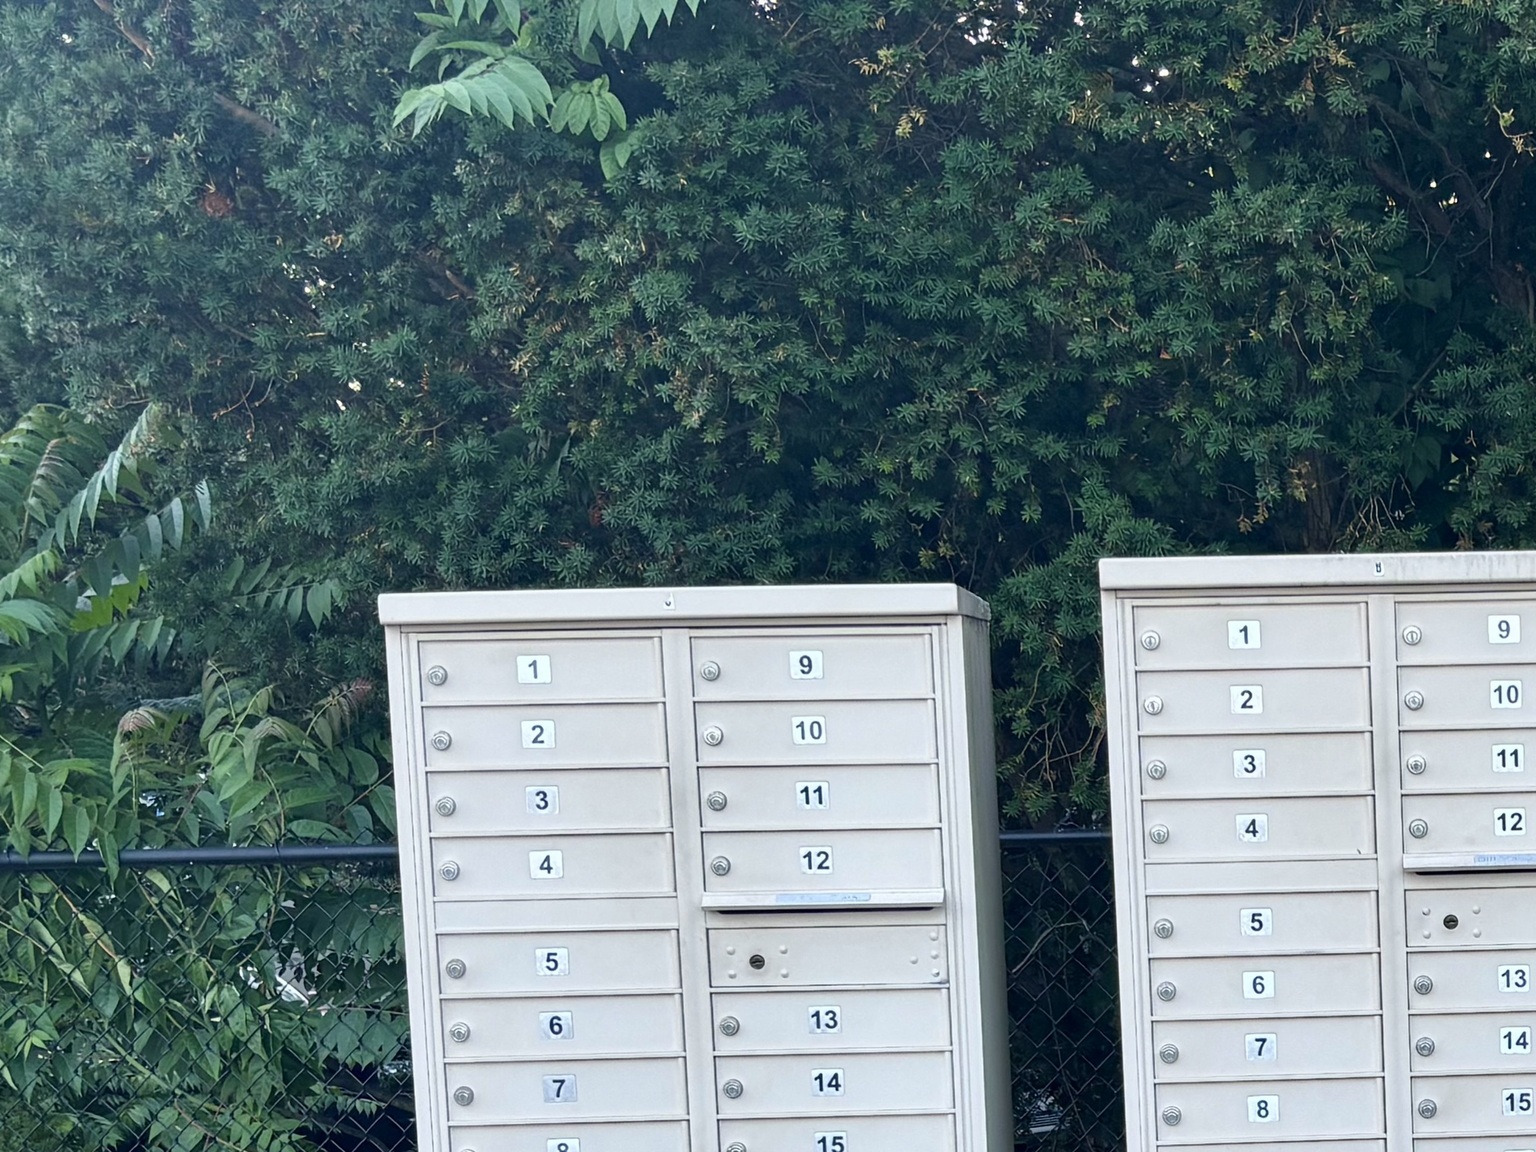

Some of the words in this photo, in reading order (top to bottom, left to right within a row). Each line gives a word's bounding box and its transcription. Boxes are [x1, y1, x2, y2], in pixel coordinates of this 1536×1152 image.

[1239, 625, 1249, 645] 1
[1498, 620, 1510, 639] 9
[528, 660, 538, 679] 1
[799, 655, 813, 675] 9
[1240, 690, 1253, 709] 2
[1493, 685, 1519, 704] 10
[531, 725, 545, 744] 2
[795, 720, 822, 740] 10
[1244, 754, 1257, 774] 3
[1497, 748, 1519, 768] 11
[535, 790, 549, 810] 3
[800, 785, 823, 805] 11
[1244, 818, 1259, 838] 4
[1497, 812, 1523, 832] 12
[539, 854, 553, 874] 4
[802, 850, 830, 870] 12
[1250, 912, 1264, 932] 5
[545, 952, 559, 972] 5
[1252, 975, 1265, 995] 6
[1501, 969, 1527, 988] 13
[549, 1015, 563, 1036] 6
[810, 1010, 838, 1030] 13
[1254, 1037, 1268, 1057] 7
[1503, 1031, 1529, 1050] 14
[552, 1079, 566, 1098] 7
[814, 1072, 842, 1092] 14
[1257, 1099, 1269, 1119] 8
[1505, 1092, 1531, 1112] 15
